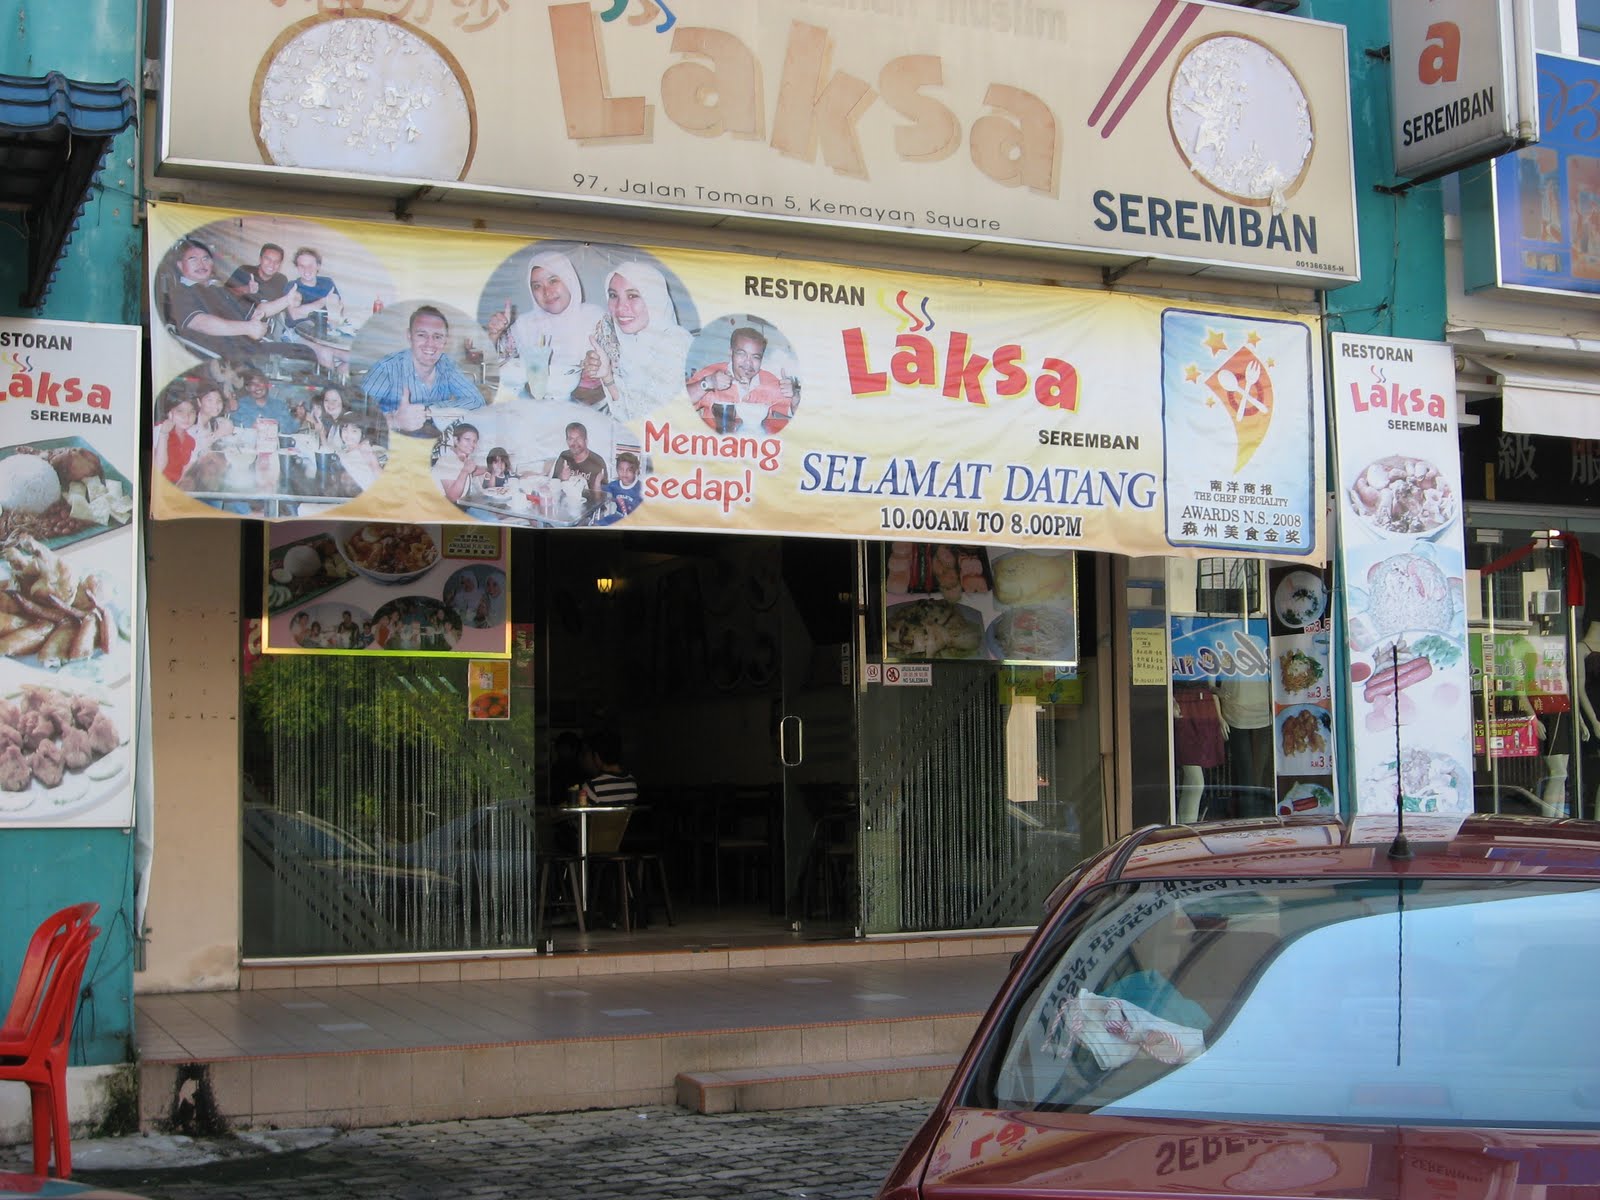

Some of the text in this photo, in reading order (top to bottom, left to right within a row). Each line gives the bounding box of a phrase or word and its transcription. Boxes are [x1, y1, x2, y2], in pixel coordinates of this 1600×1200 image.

[548, 1, 1061, 199] Laksa
[1402, 86, 1495, 147] SEREMBAN
[572, 173, 1001, 231] 97, Jalan Toman 5, Kemayan Square
[1093, 189, 1318, 255] SEREMBAN
[743, 275, 866, 307] RESTORAN
[841, 325, 1083, 414] Laksa
[1341, 343, 1413, 362] RESTORAN
[30, 409, 112, 425] SEREMBAN
[1350, 382, 1445, 419] Laksa
[1038, 429, 1140, 451] SEREMBAN
[1387, 419, 1448, 433] SEREMBAN
[644, 420, 782, 472] Memang
[644, 468, 752, 513] sedap!
[800, 452, 1158, 509] SELAMAT DATANG
[1181, 504, 1302, 528] AWARDS N.S. 2008
[1194, 491, 1289, 508] THE CHEF SPECIALITY
[881, 506, 1083, 538] 10.00AM TO 8.00PM
